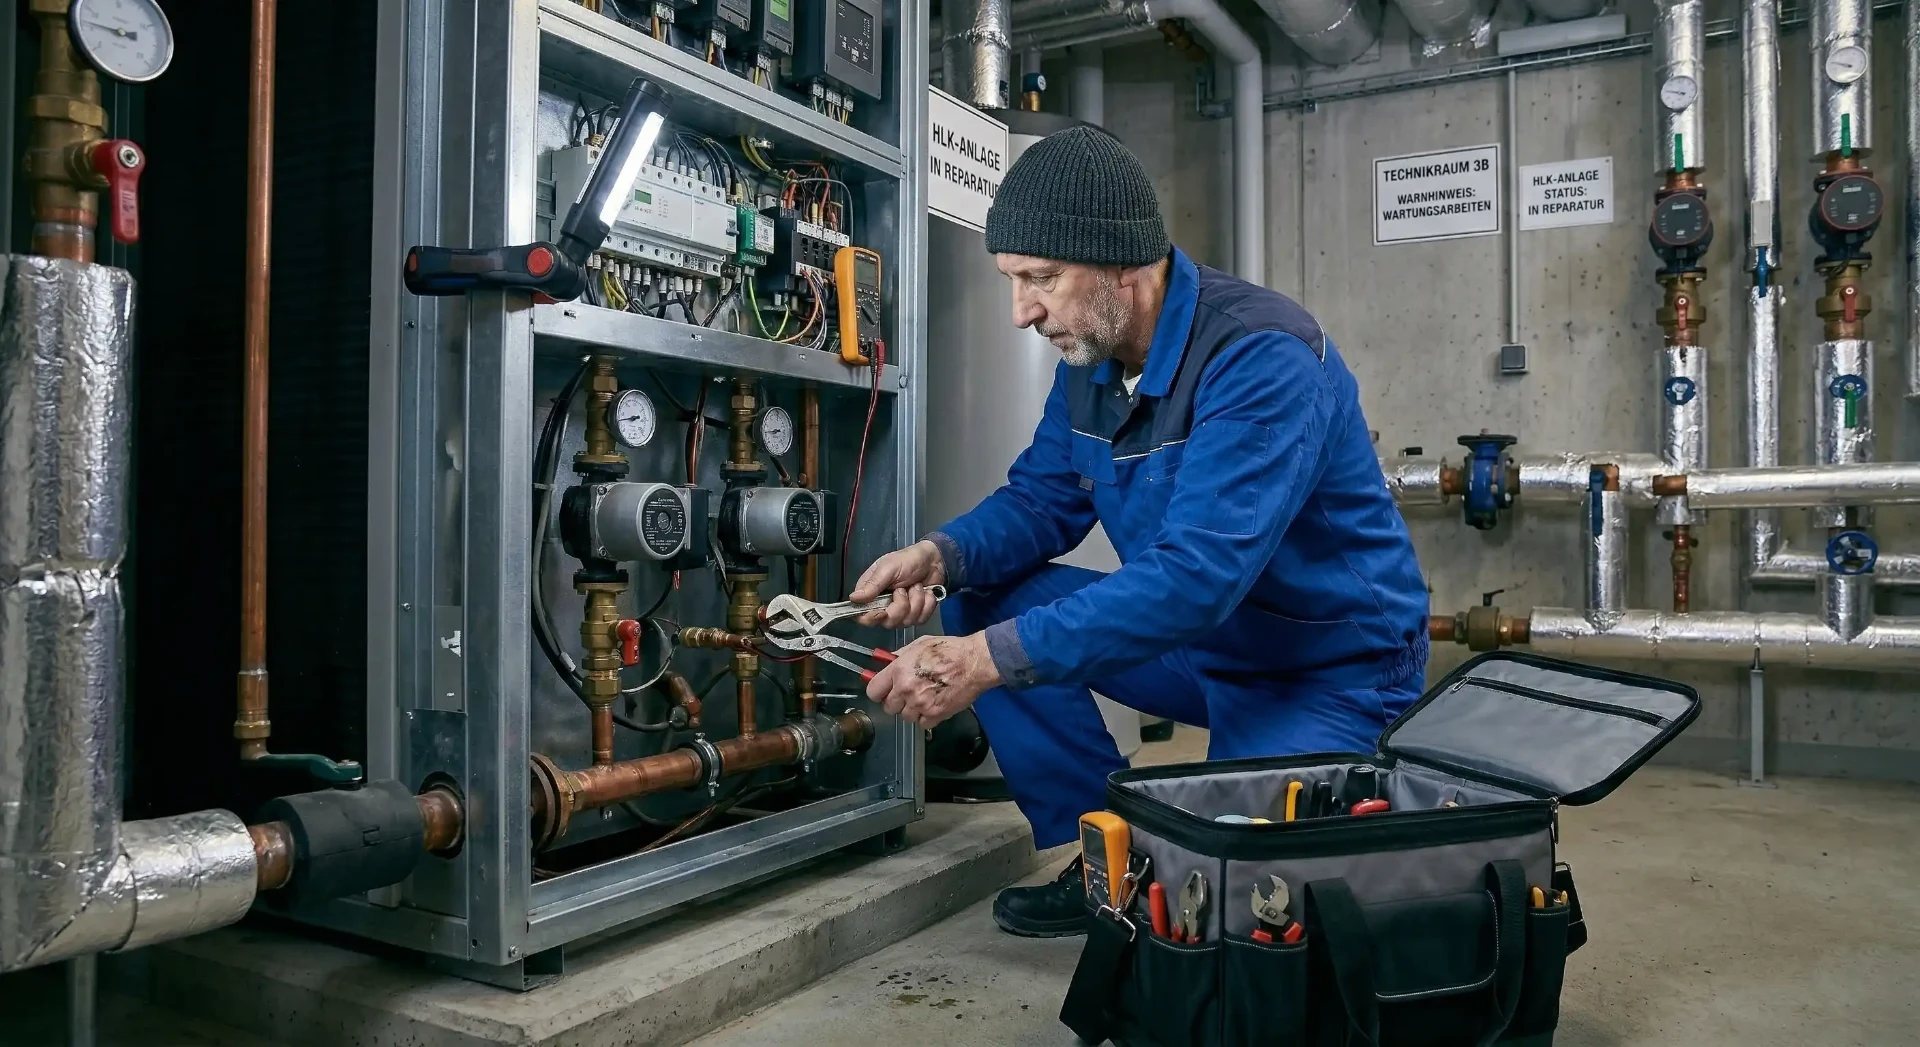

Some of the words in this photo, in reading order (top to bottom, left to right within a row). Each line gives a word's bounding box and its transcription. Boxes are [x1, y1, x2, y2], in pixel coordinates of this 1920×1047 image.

[932, 122, 1001, 171] HLK-ANLAGE
[930, 155, 941, 177] IN
[1383, 160, 1469, 182] TECHNIKRAUM
[1473, 158, 1490, 172] 3B
[1532, 170, 1600, 187] HLK-ANLAGE
[1397, 187, 1476, 205] WARNHINWEIS:
[1544, 186, 1588, 200] STATUS:
[1382, 200, 1492, 221] WARTUNGSARBEITEN
[1528, 204, 1540, 216] IN
[1542, 199, 1605, 215] REPARATUR
